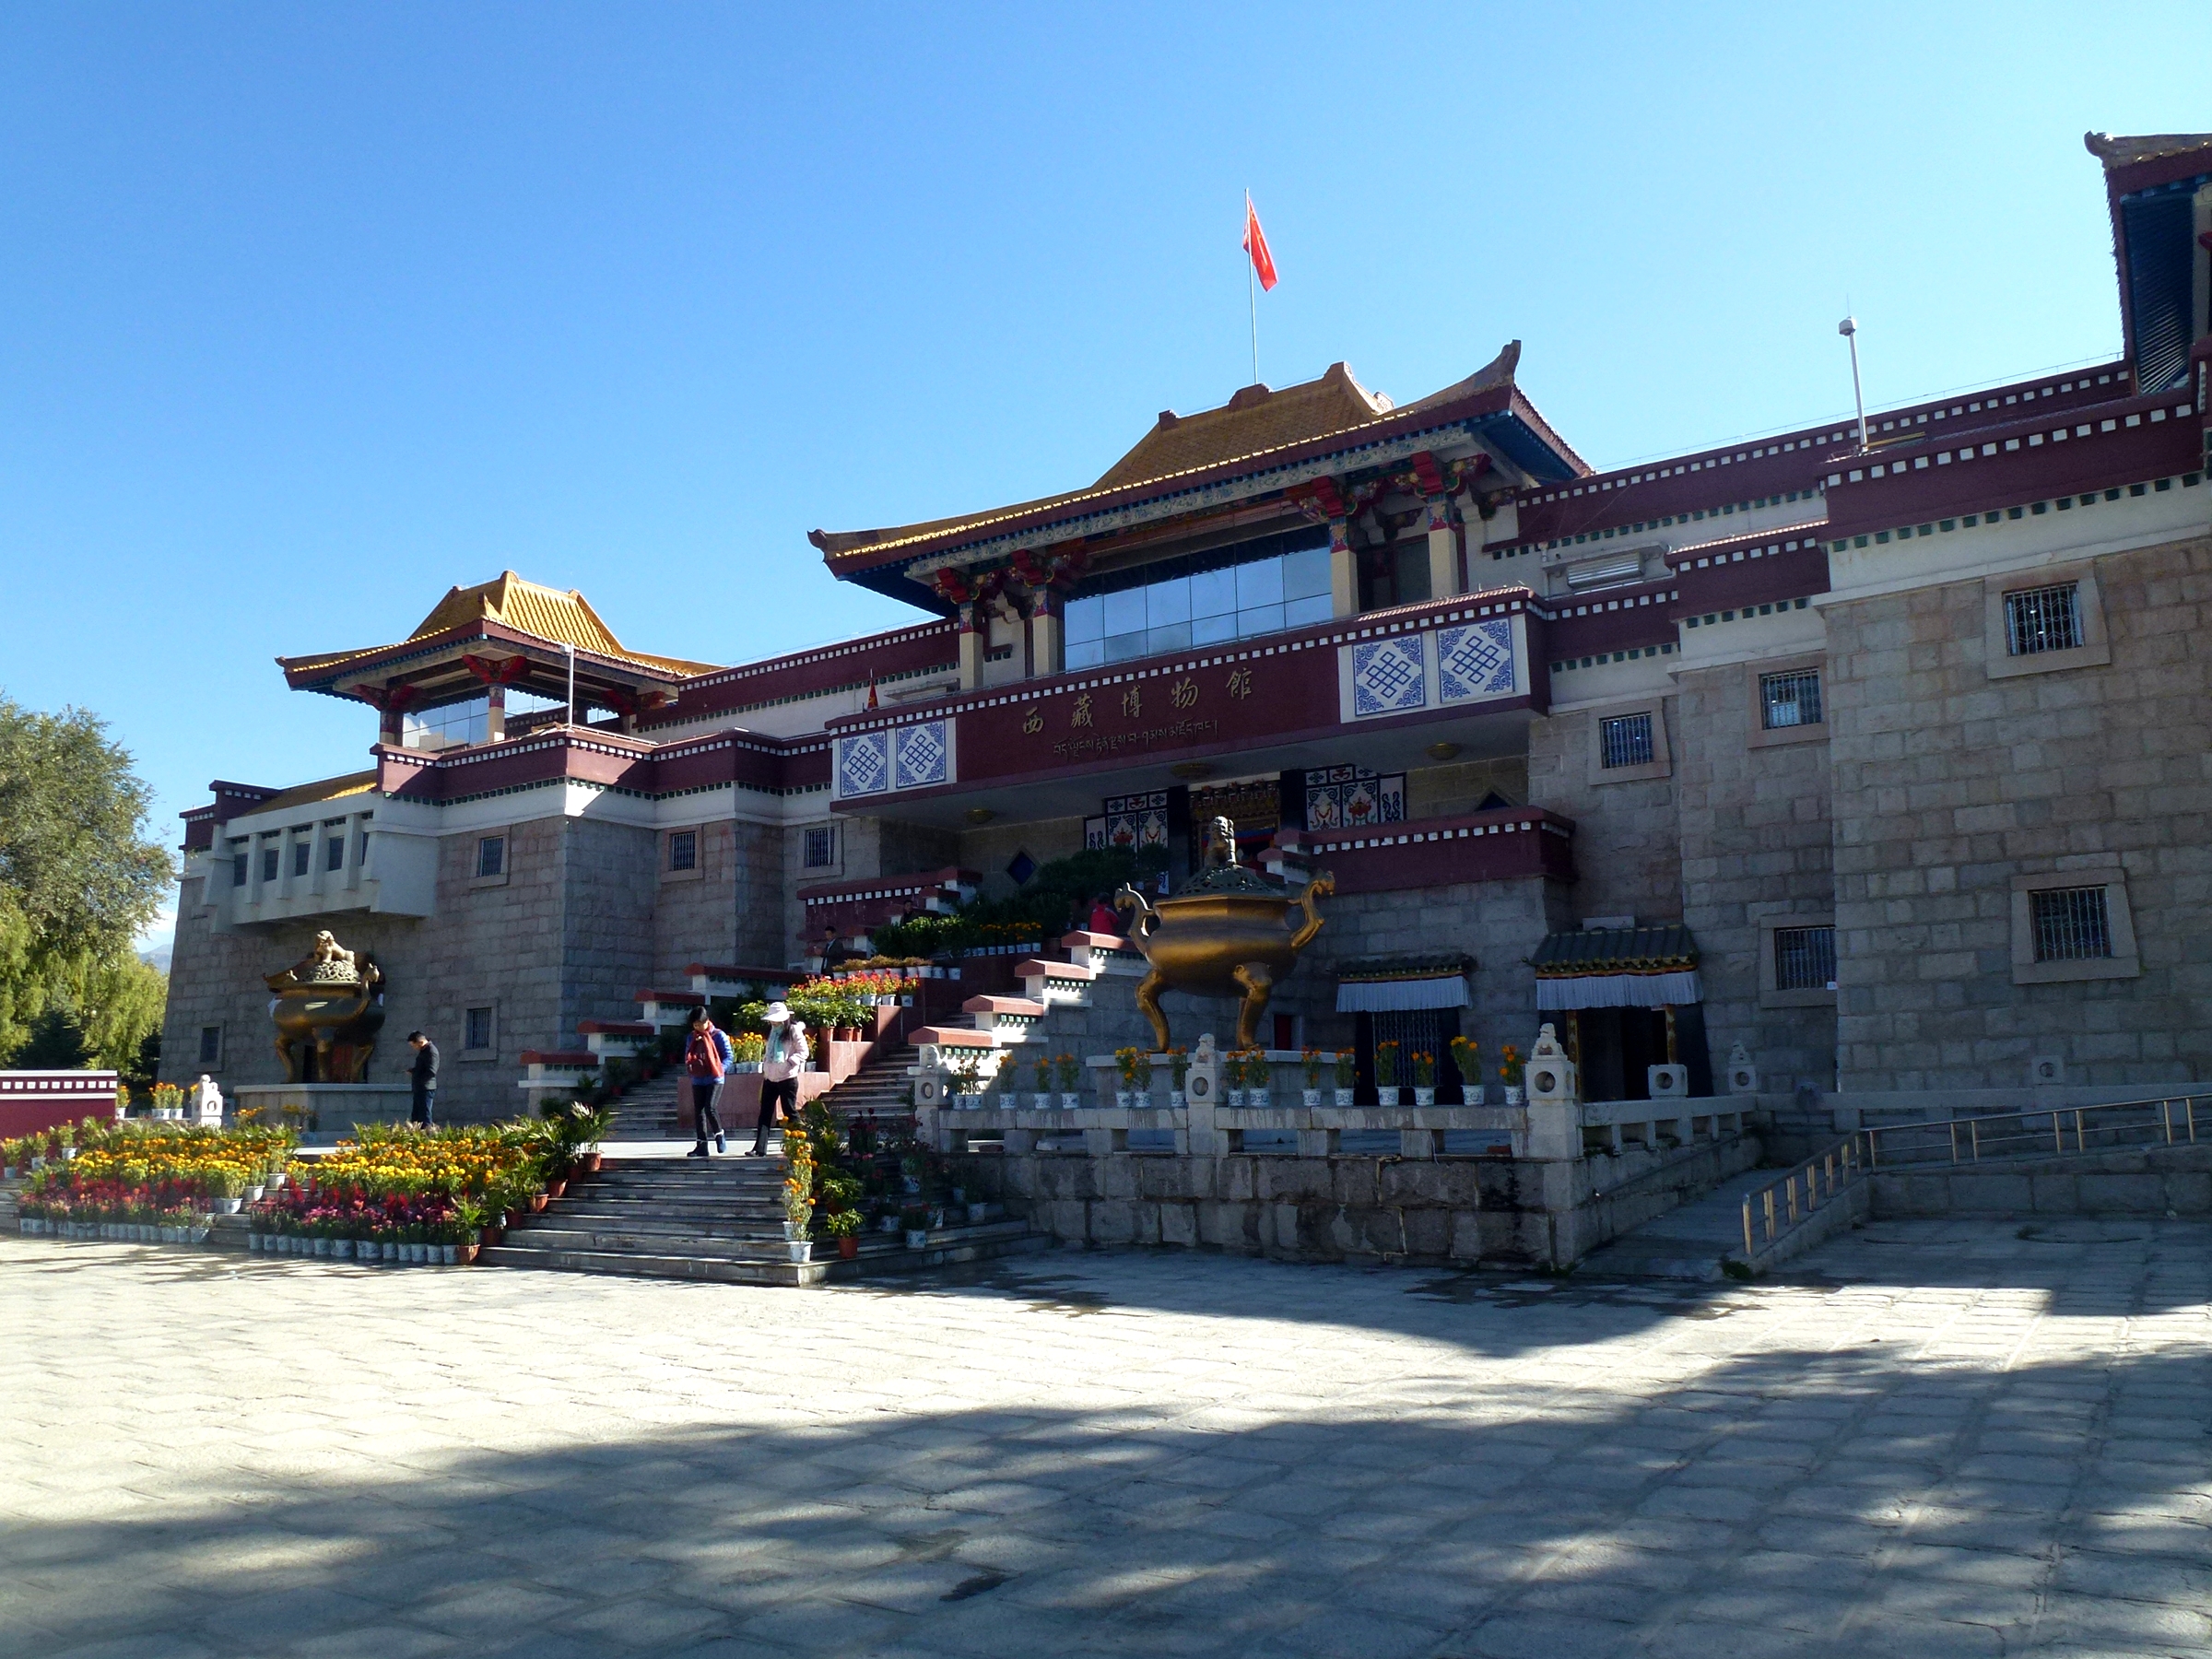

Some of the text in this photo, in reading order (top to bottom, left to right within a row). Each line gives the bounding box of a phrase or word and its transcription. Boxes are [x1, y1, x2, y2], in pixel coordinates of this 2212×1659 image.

[1022, 667, 1253, 735] 西藏博物館
